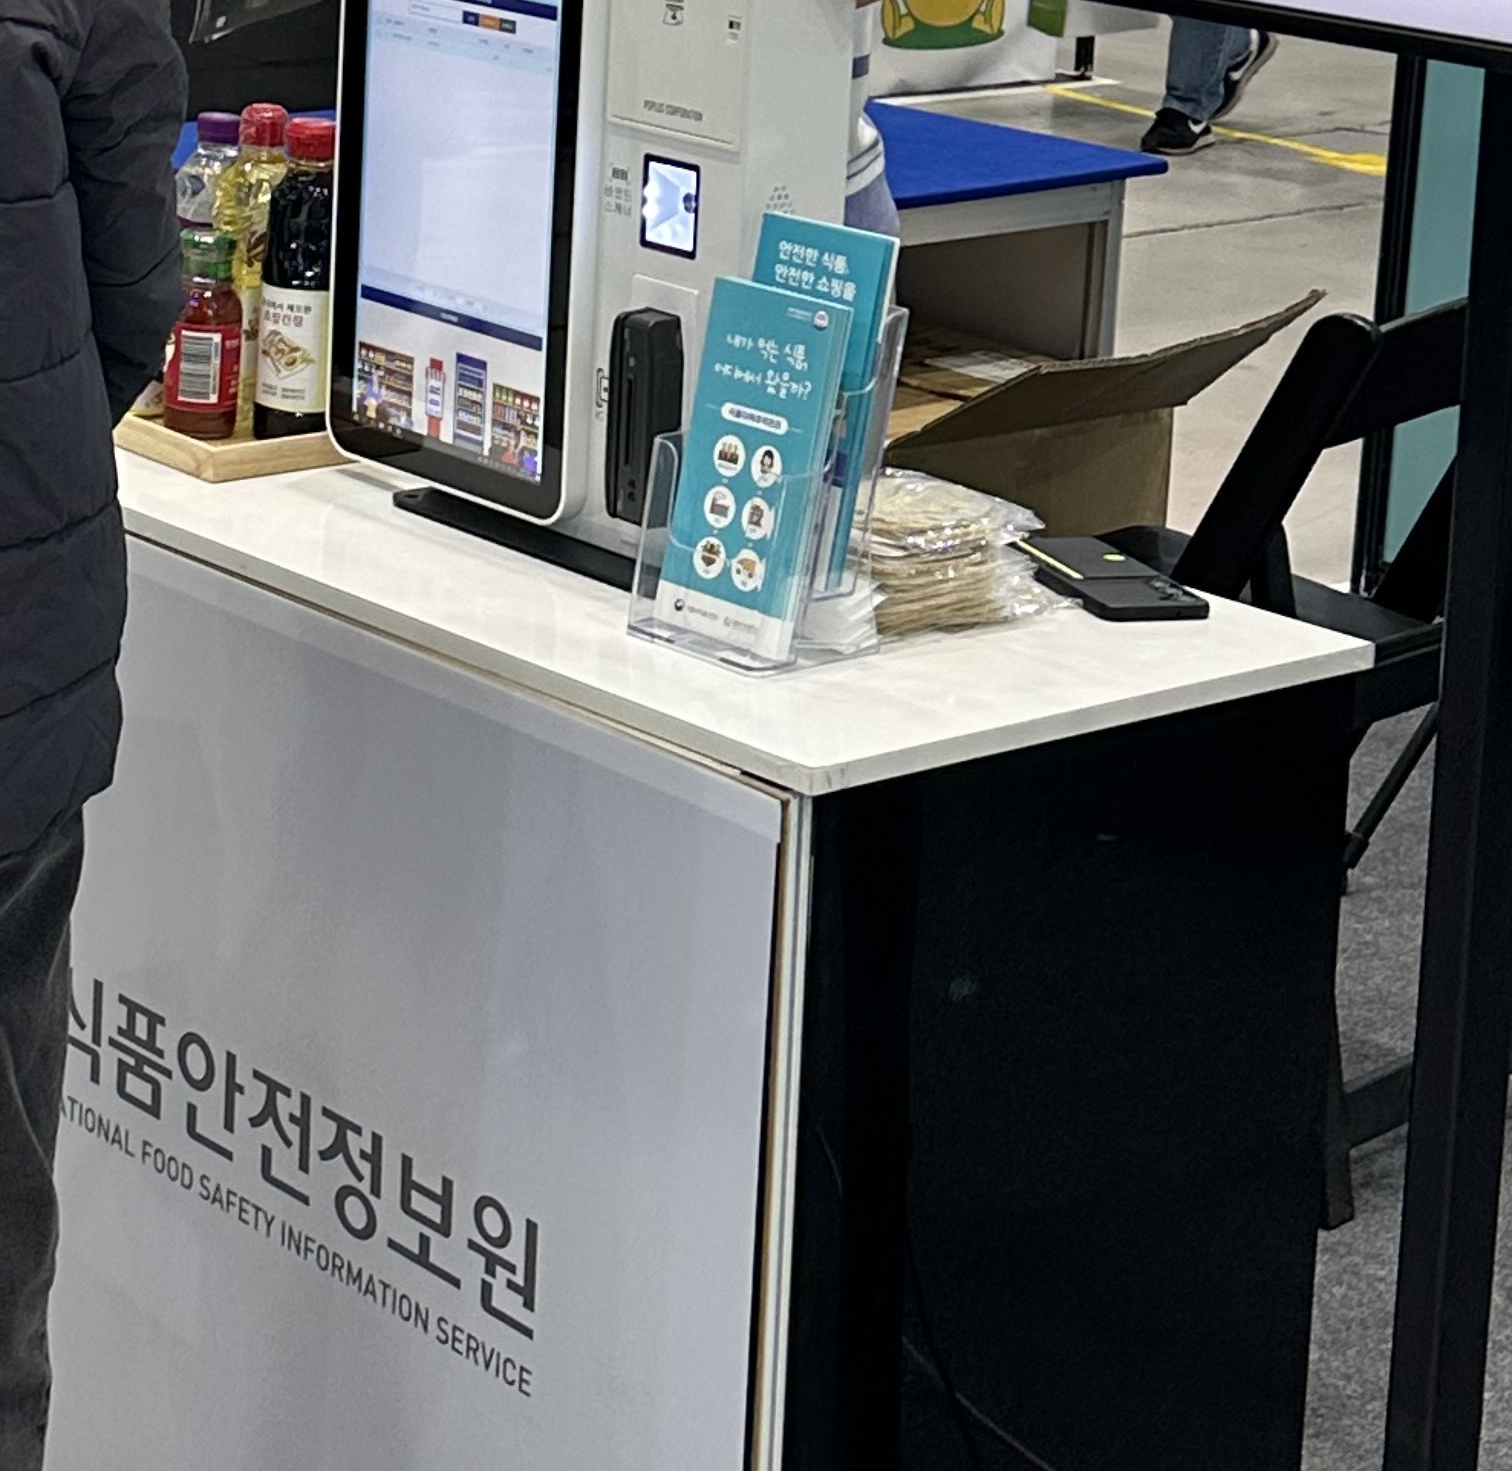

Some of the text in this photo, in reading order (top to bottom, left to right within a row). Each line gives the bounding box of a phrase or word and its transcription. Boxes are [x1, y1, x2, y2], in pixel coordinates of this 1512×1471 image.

[774, 263, 816, 290] 안전한
[778, 240, 820, 267] 안전한
[67, 967, 539, 1341] 식품안전정보원
[141, 1139, 195, 1192] FOOD
[198, 1174, 277, 1239] SAFETY
[280, 1219, 430, 1335] INFORMATION
[435, 1315, 534, 1399] SERVICE
